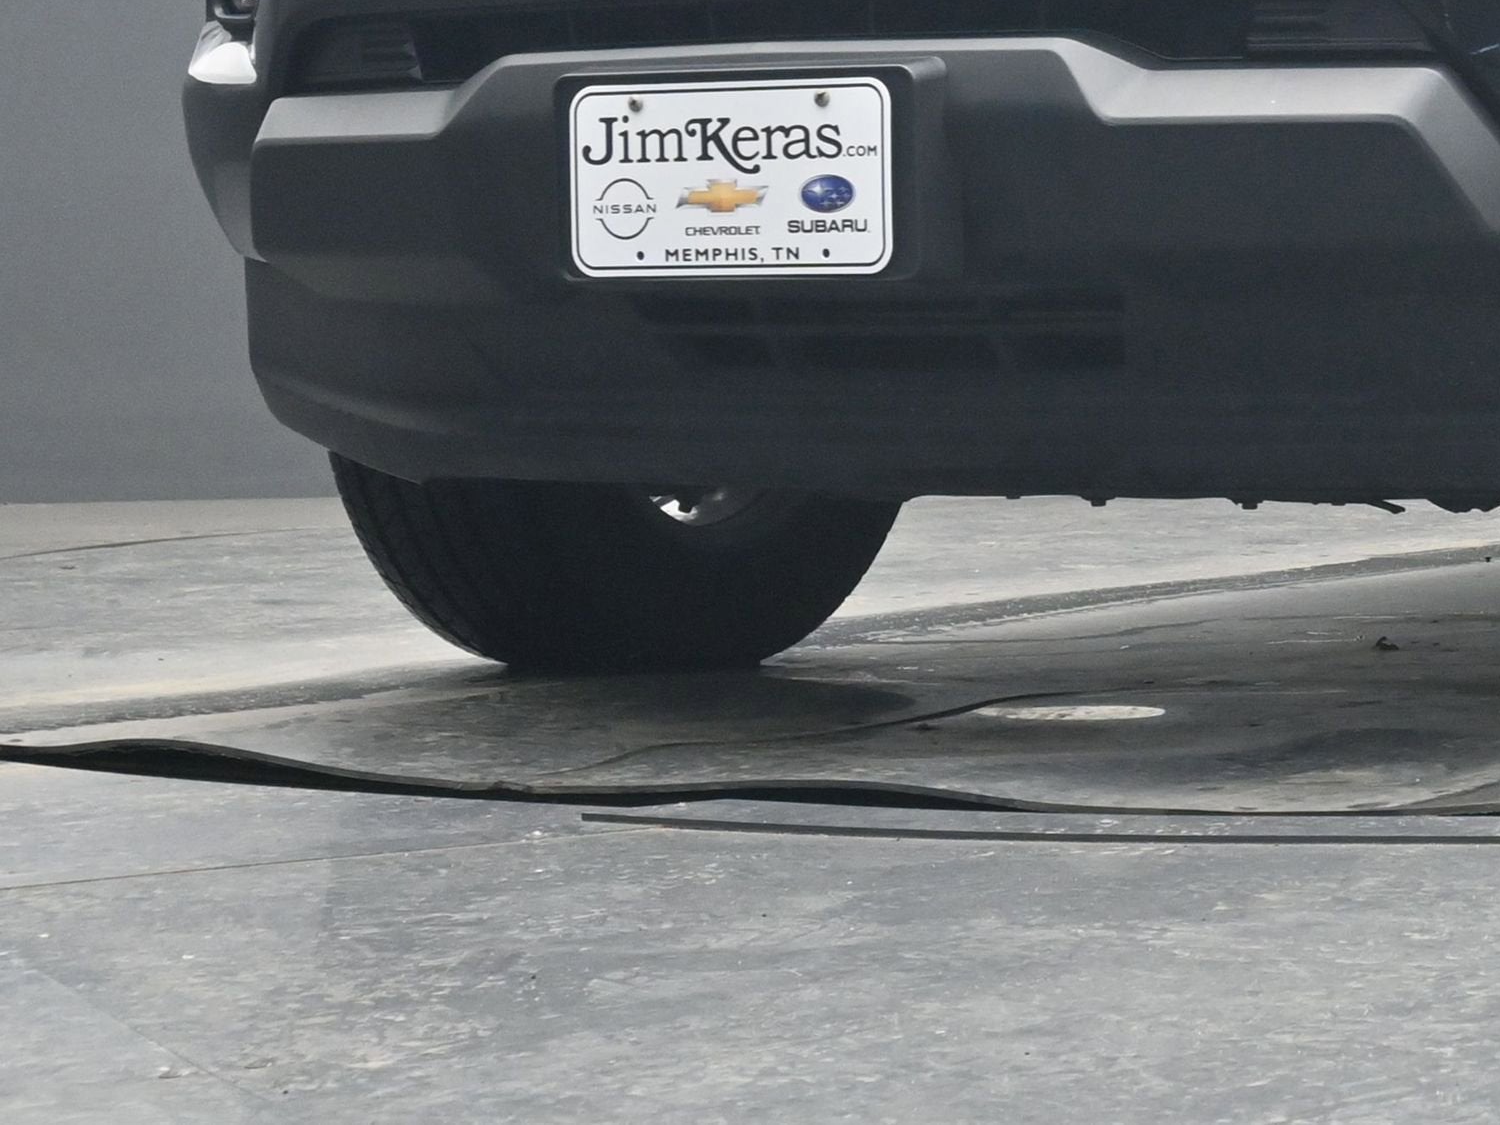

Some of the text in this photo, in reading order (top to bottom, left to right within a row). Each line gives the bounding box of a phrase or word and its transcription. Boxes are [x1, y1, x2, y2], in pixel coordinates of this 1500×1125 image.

[593, 203, 657, 215] NISSAN
[685, 225, 760, 237] CHEVROLET
[787, 219, 868, 235] SUBARU
[664, 247, 800, 263] MEMPHIS, TN
